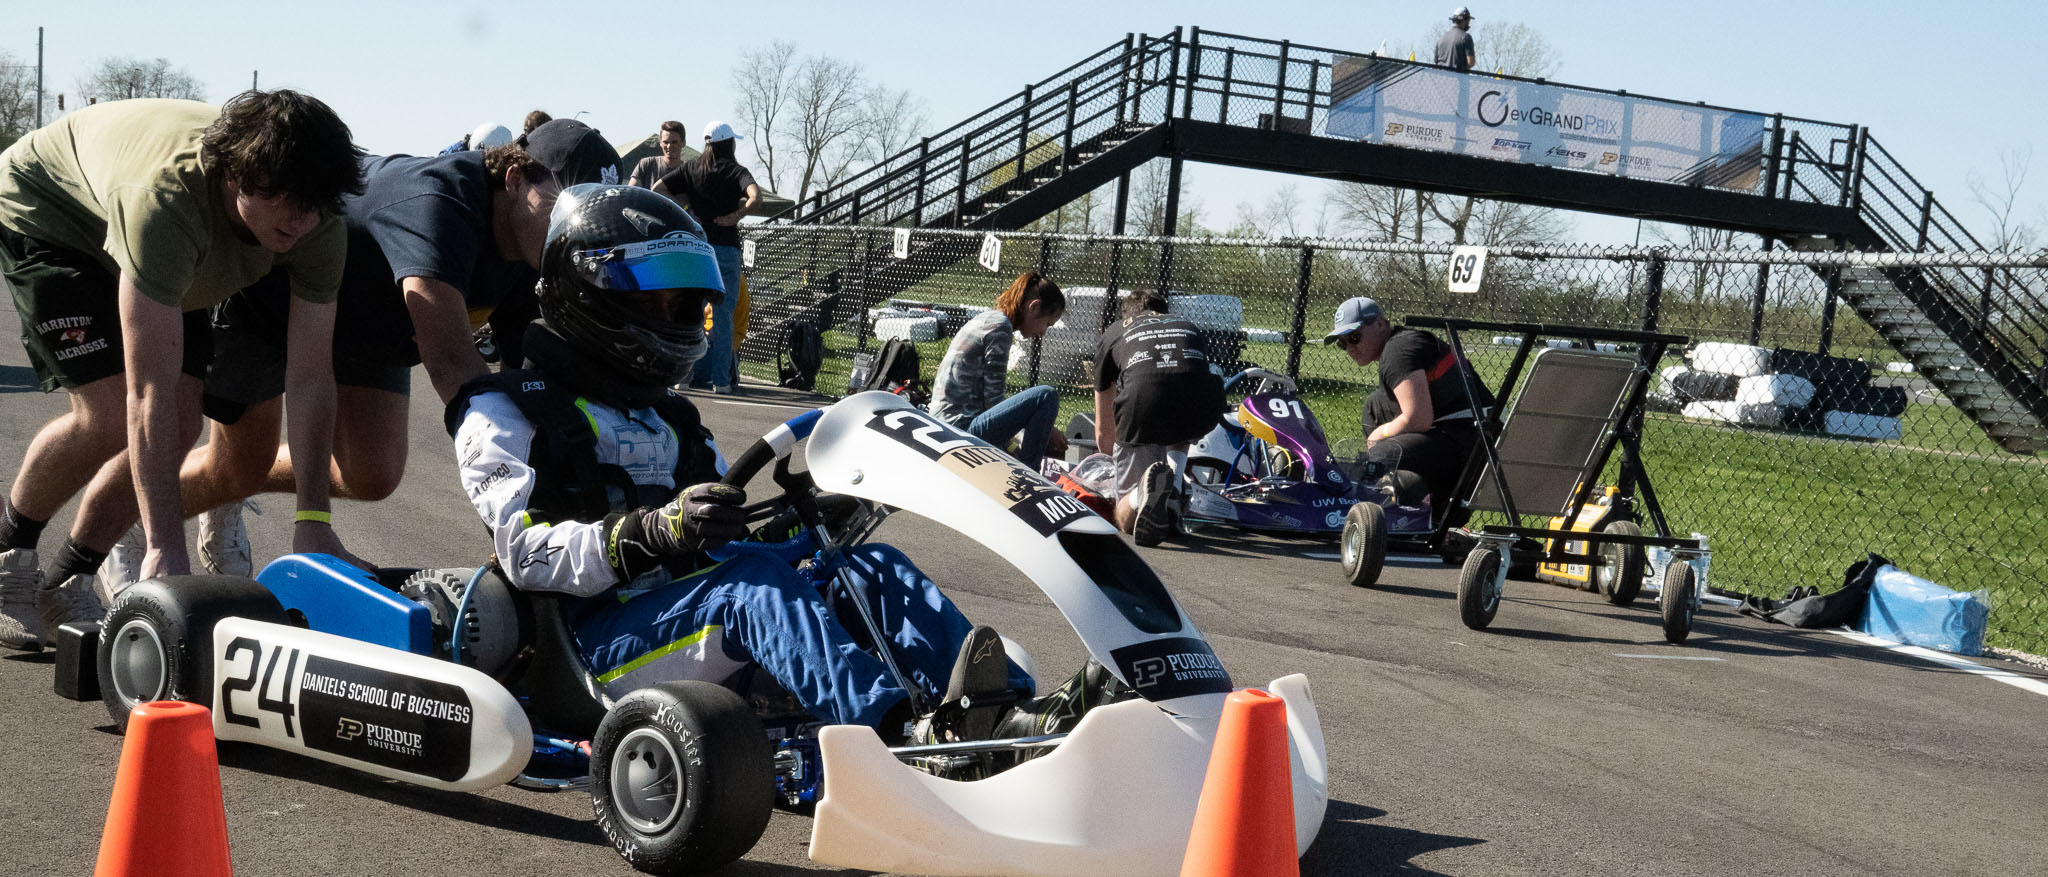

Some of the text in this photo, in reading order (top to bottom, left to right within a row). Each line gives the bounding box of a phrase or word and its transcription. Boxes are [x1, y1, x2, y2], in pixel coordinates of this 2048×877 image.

[1406, 125, 1443, 138] PURDUE
[1619, 154, 1651, 167] PURDUE
[983, 237, 997, 267] 80
[1452, 254, 1477, 284] 69
[36, 316, 93, 335] HARRITON
[55, 338, 108, 361] LACROSSE
[1269, 398, 1304, 420] 91
[1312, 496, 1335, 508] UW
[1166, 653, 1220, 671] PURDUE
[222, 636, 300, 738] 24
[302, 672, 470, 724] DANIELS SCHOOL OF BUSINESS
[366, 723, 423, 749] PURDUE
[651, 702, 703, 766] Hoosier
[367, 738, 424, 757] UNIVERSITY
